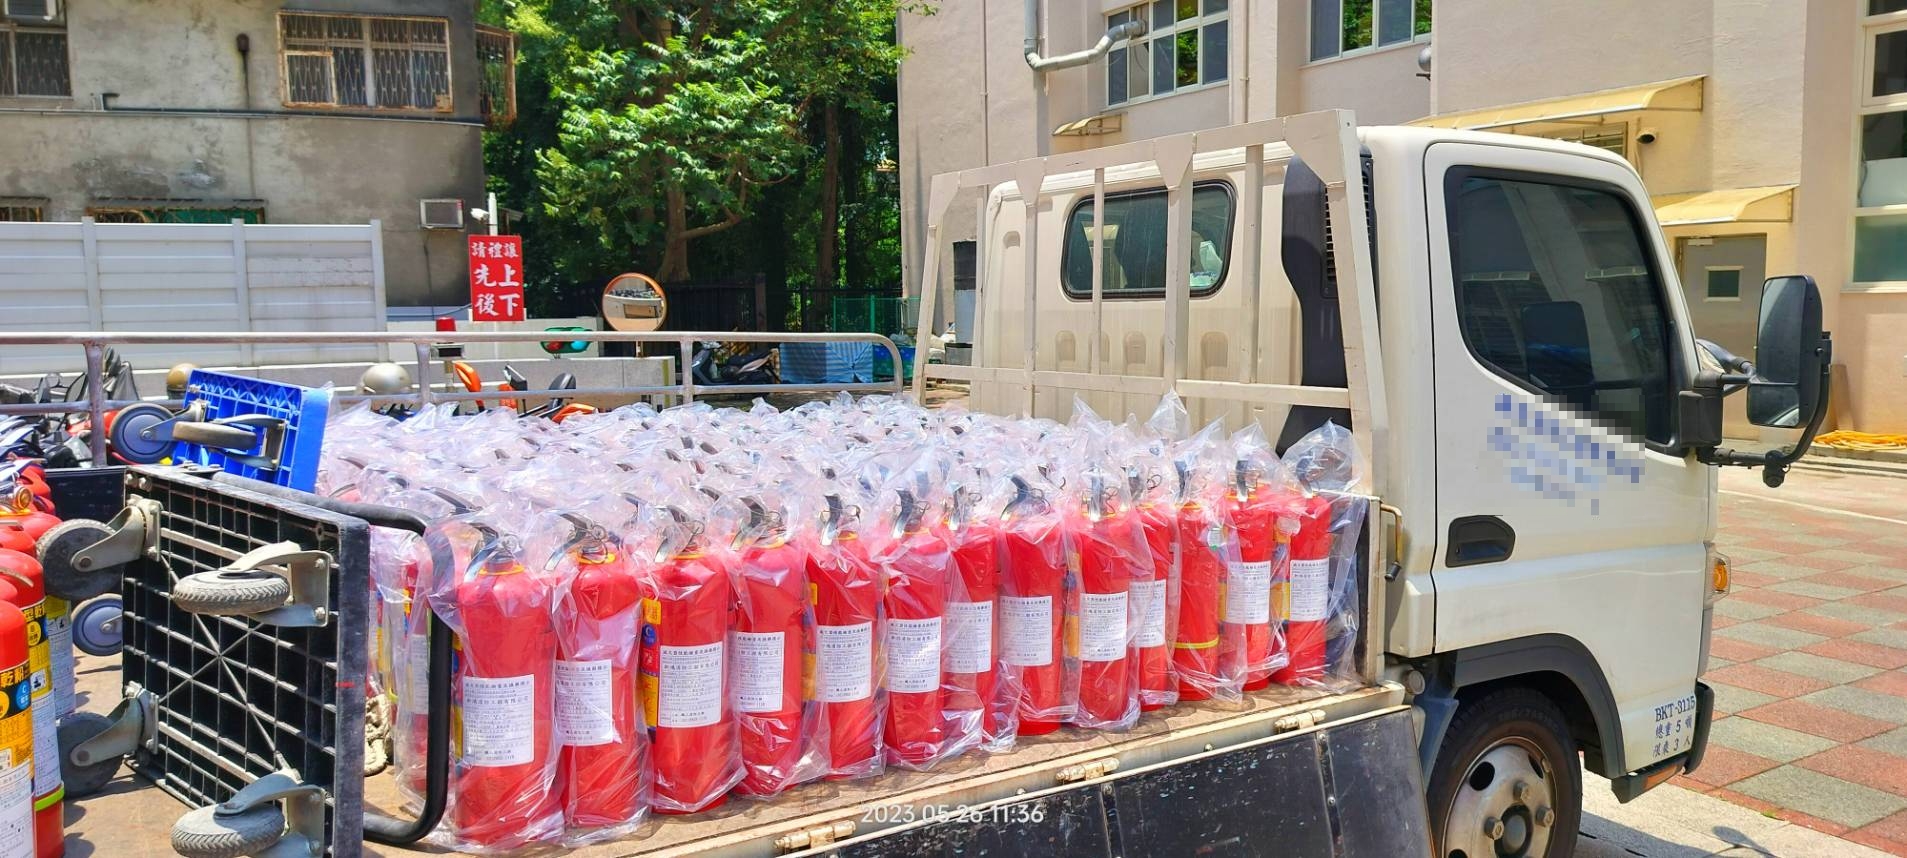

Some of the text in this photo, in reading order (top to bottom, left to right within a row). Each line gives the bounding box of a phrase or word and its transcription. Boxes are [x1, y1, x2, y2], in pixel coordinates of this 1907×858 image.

[1655, 696, 1696, 722] BKT-3115
[1676, 719, 1682, 733] 5
[1673, 738, 1679, 751] 3
